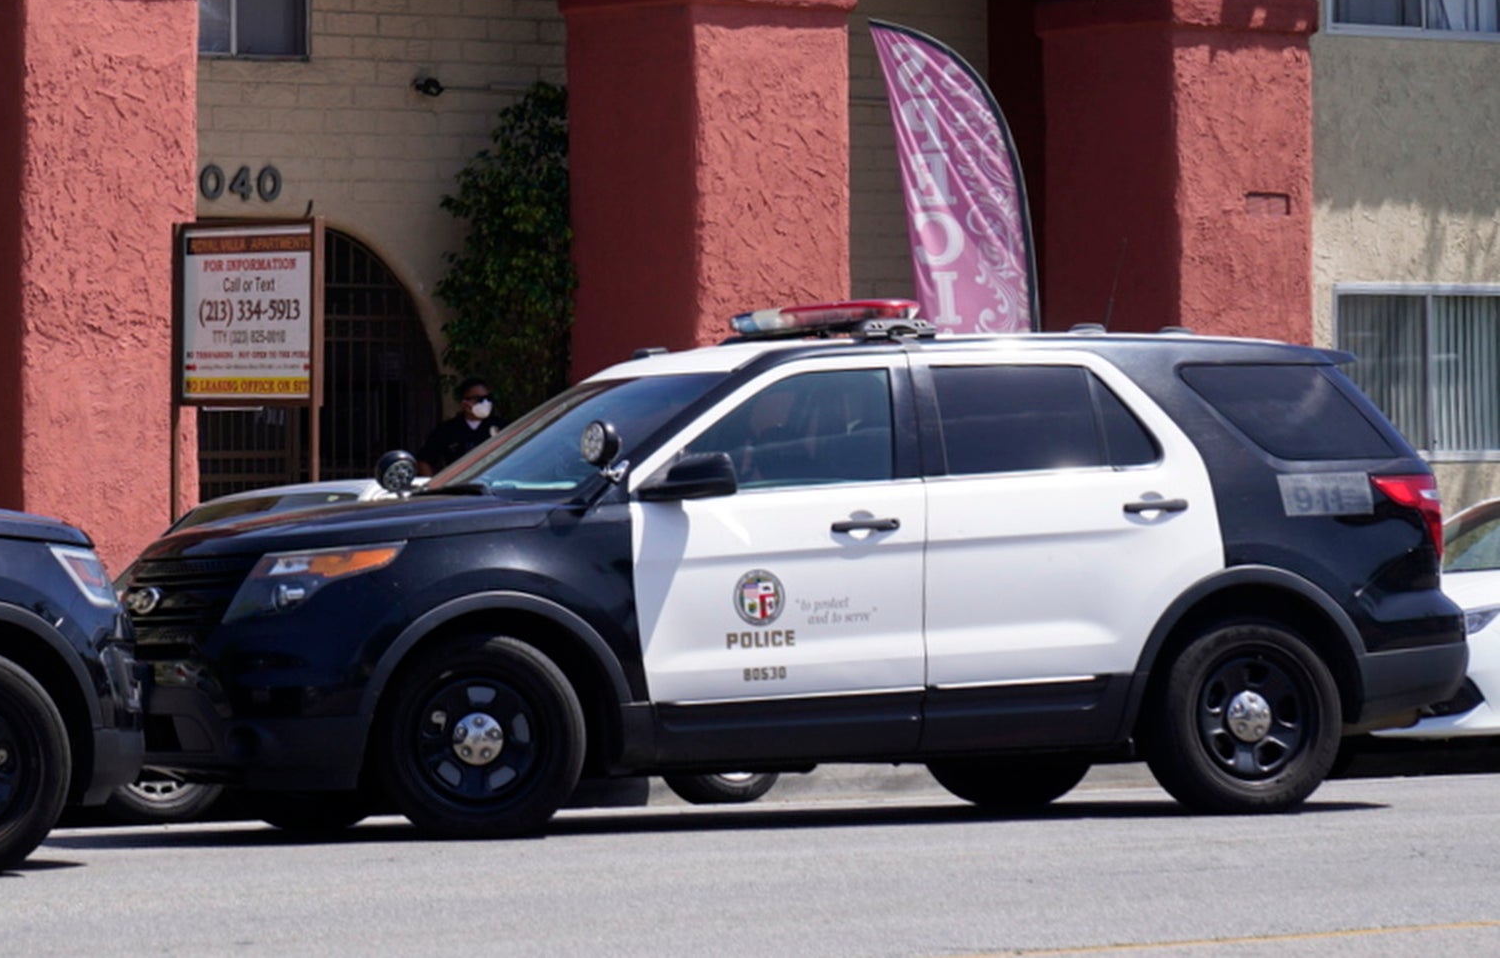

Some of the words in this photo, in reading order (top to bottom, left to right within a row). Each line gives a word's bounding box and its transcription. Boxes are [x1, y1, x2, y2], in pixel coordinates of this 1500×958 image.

[203, 260, 223, 272] FOR
[226, 258, 296, 271] INFORMATION
[223, 277, 240, 292] Call
[242, 281, 252, 292] or
[255, 277, 275, 292] Text
[198, 300, 233, 328] (213)
[237, 299, 300, 321] 334-5913
[813, 597, 850, 613] protect
[807, 612, 828, 625] and
[832, 611, 842, 623] to
[726, 630, 795, 649] POLICE
